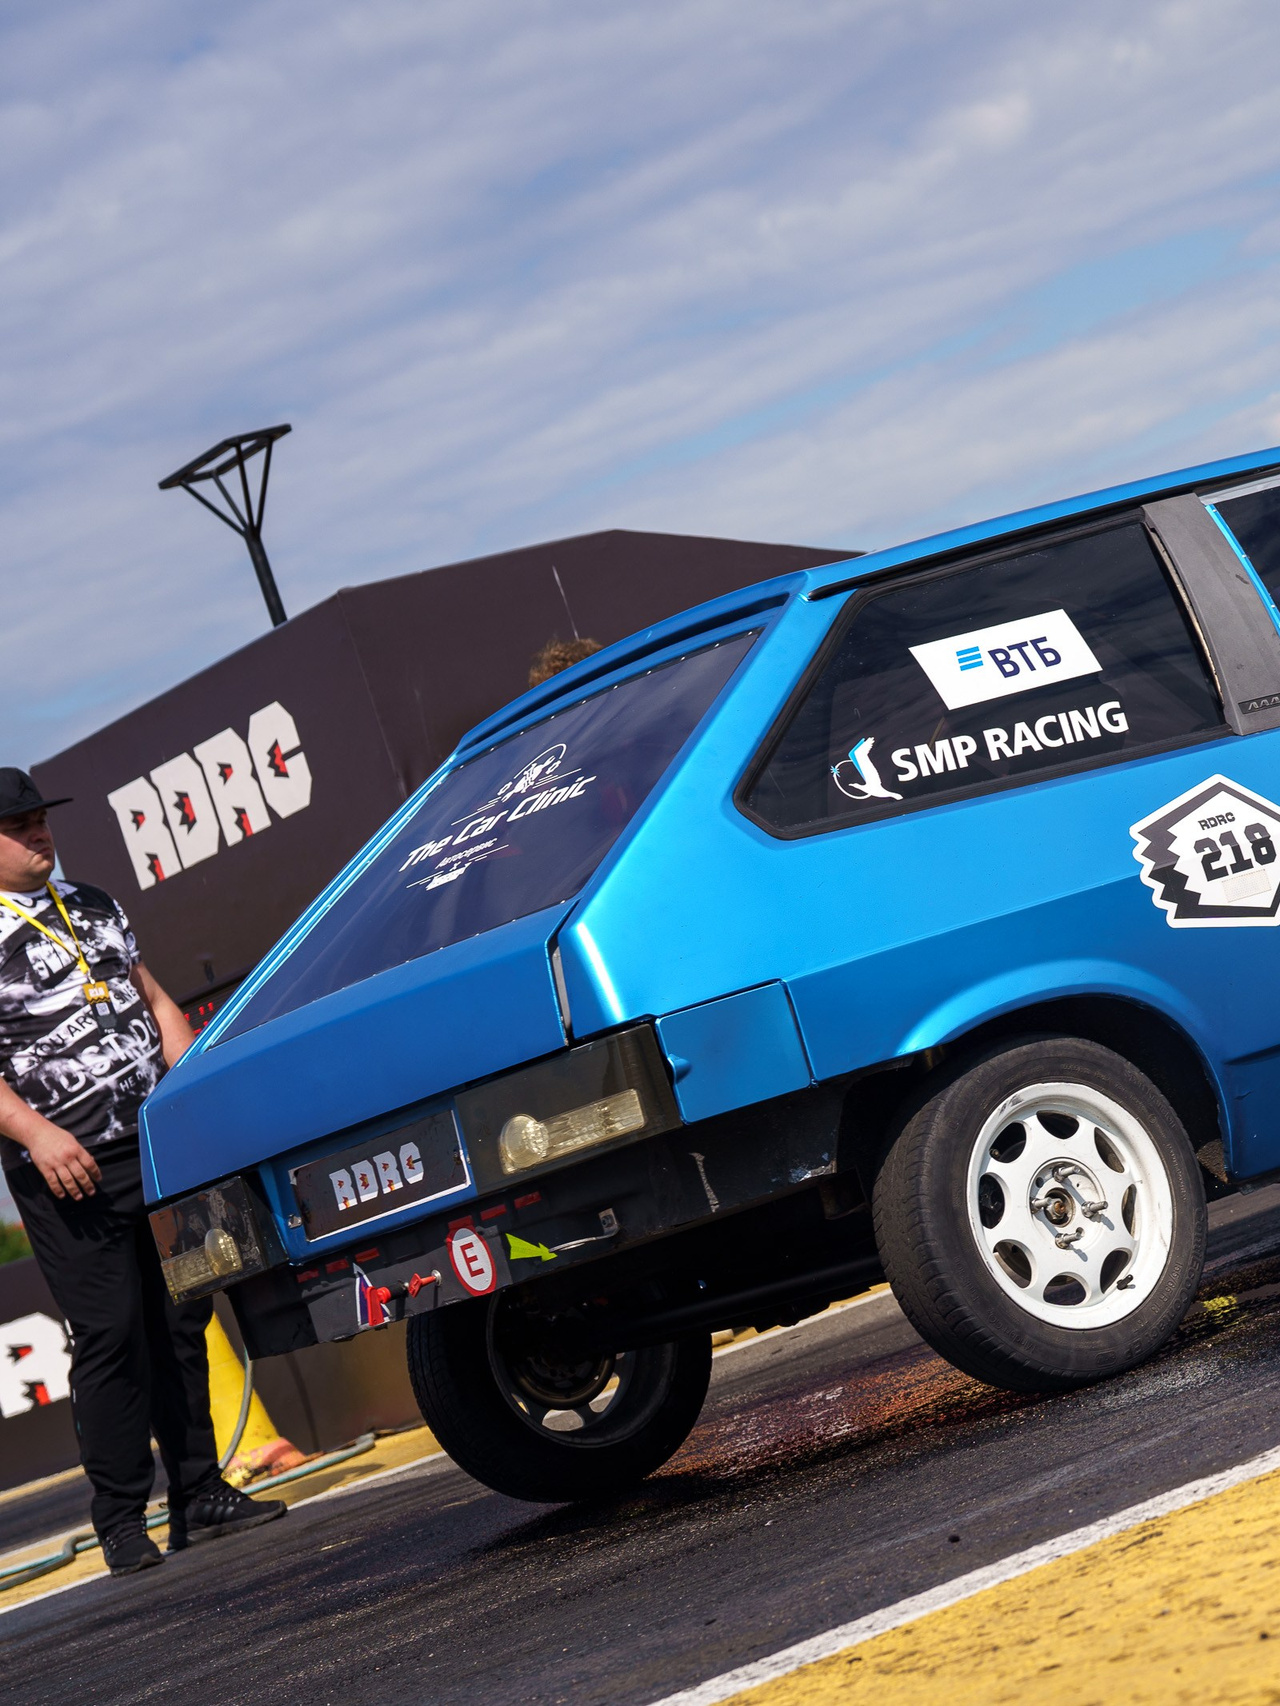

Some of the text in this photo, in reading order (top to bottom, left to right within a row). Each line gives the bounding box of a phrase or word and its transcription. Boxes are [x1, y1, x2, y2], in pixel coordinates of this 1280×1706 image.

[987, 636, 1062, 679] ВТБ
[891, 701, 1130, 782] SMP RACING
[107, 700, 313, 891] RDRC
[399, 775, 598, 872] The Car Clinic
[1197, 811, 1236, 831] RDRC
[1193, 822, 1277, 882] 218
[329, 1141, 424, 1211] RDRC
[460, 1242, 485, 1278] E
